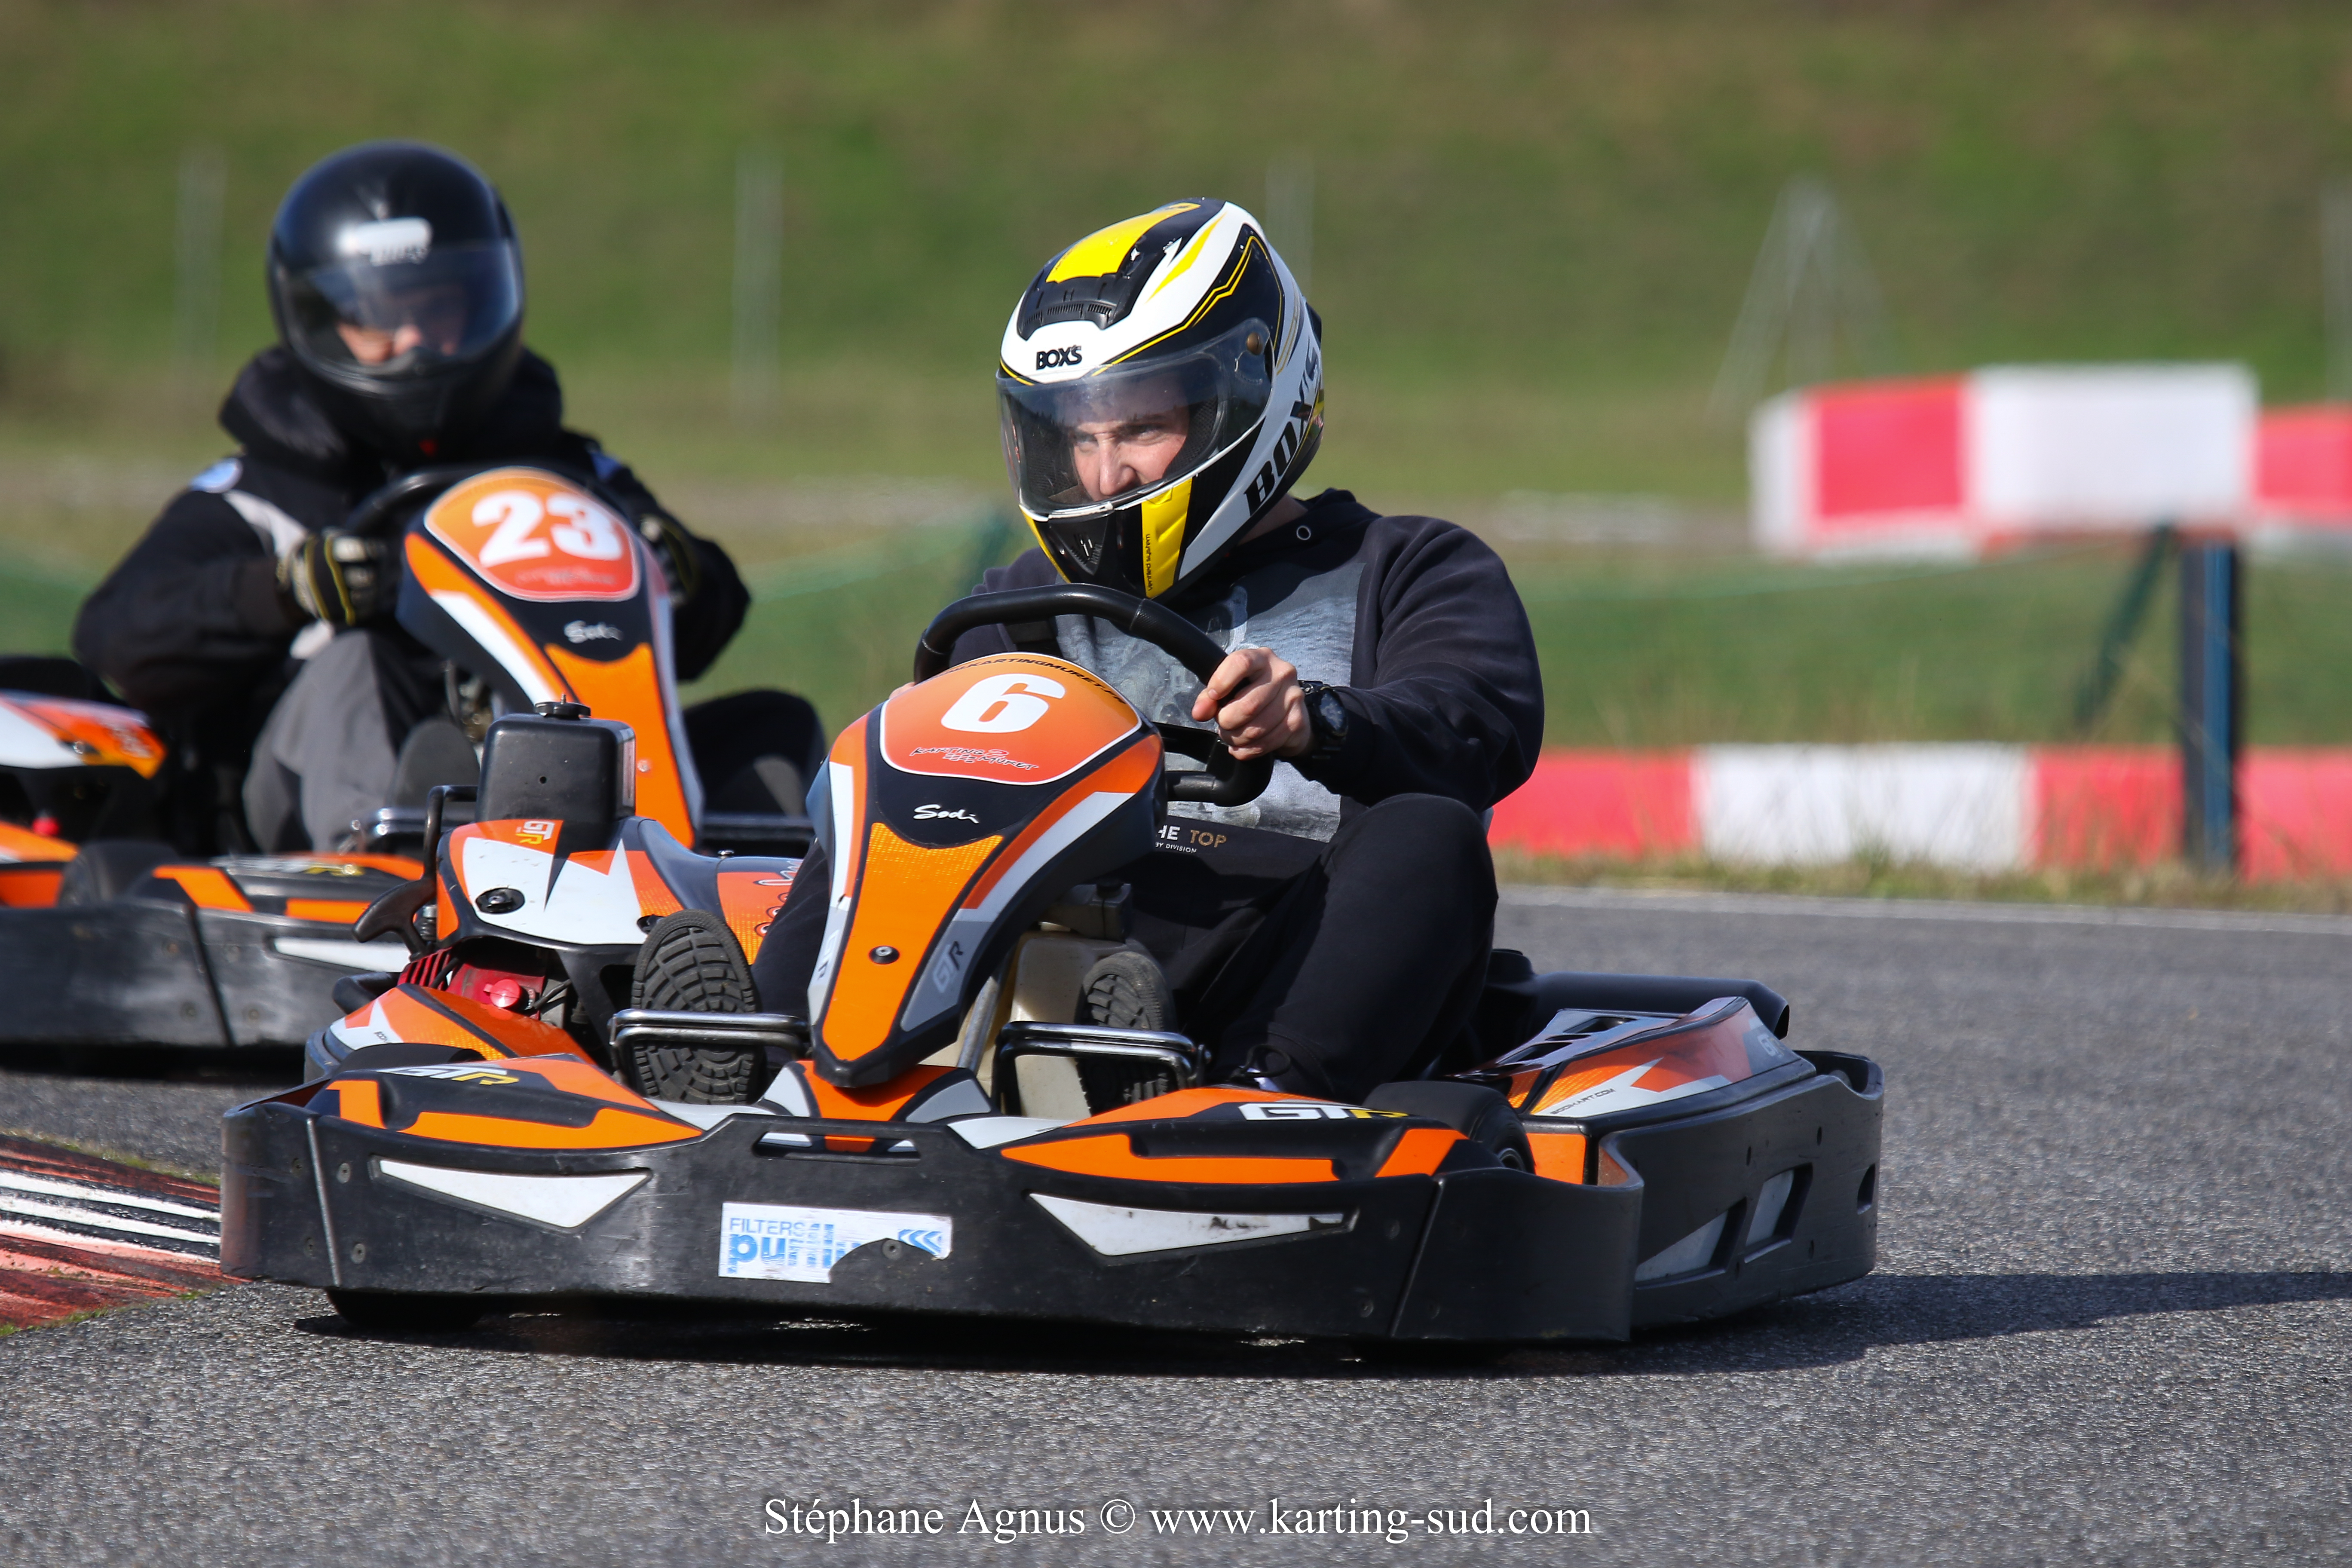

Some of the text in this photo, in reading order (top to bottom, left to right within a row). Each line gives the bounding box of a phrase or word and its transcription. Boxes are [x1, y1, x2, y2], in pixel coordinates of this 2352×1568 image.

[1036, 344, 1082, 371] BOX'S
[472, 489, 623, 568] 23
[940, 673, 1066, 733] 6
[909, 747, 986, 757] KARTING
[977, 755, 1039, 770] MURET
[913, 803, 979, 824] Sodi
[1165, 843, 1197, 854] DIVISION
[1190, 829, 1227, 848] TOP
[730, 1217, 806, 1237] FILTERS
